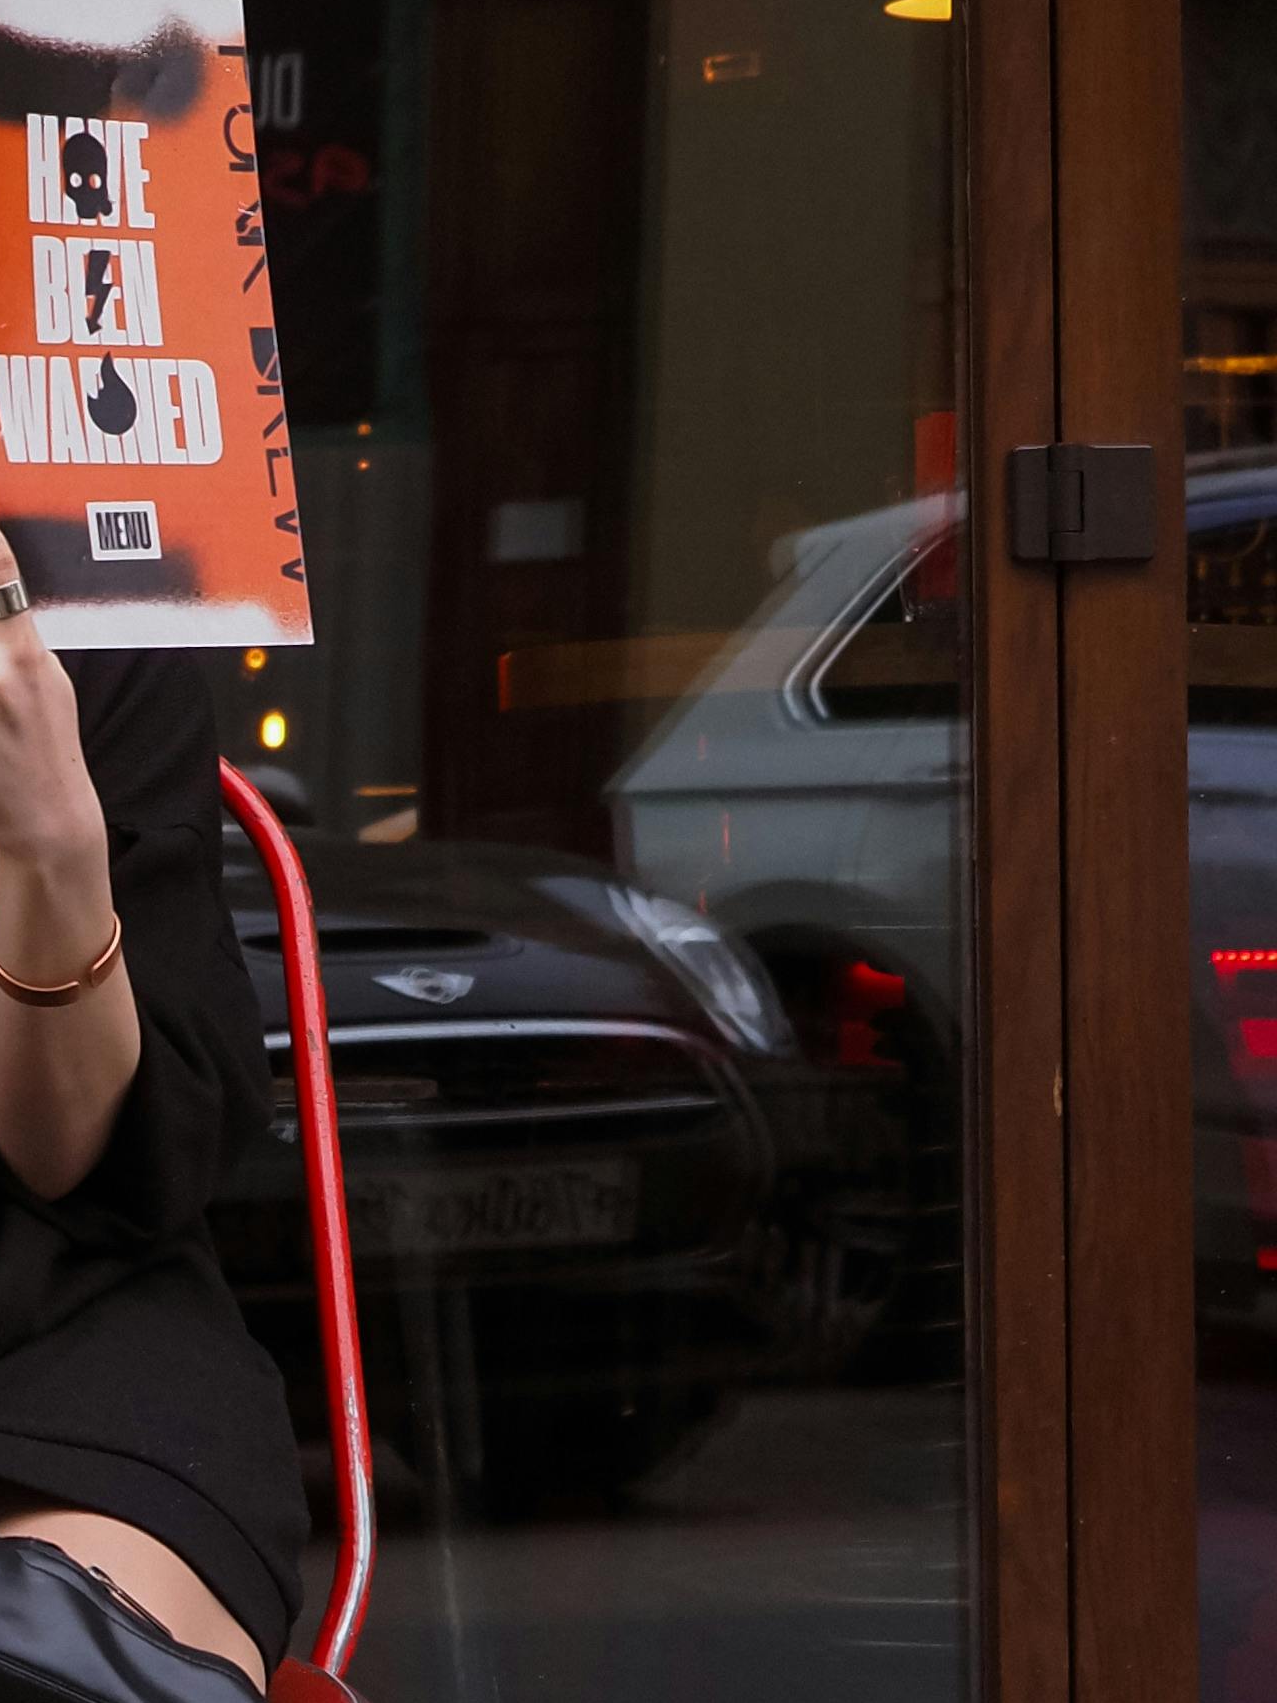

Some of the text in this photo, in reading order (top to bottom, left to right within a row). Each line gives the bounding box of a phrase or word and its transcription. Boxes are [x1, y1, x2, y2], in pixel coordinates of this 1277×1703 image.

[26, 113, 156, 229] HVE
[32, 235, 164, 347] BEEN
[95, 510, 152, 551] MENU
